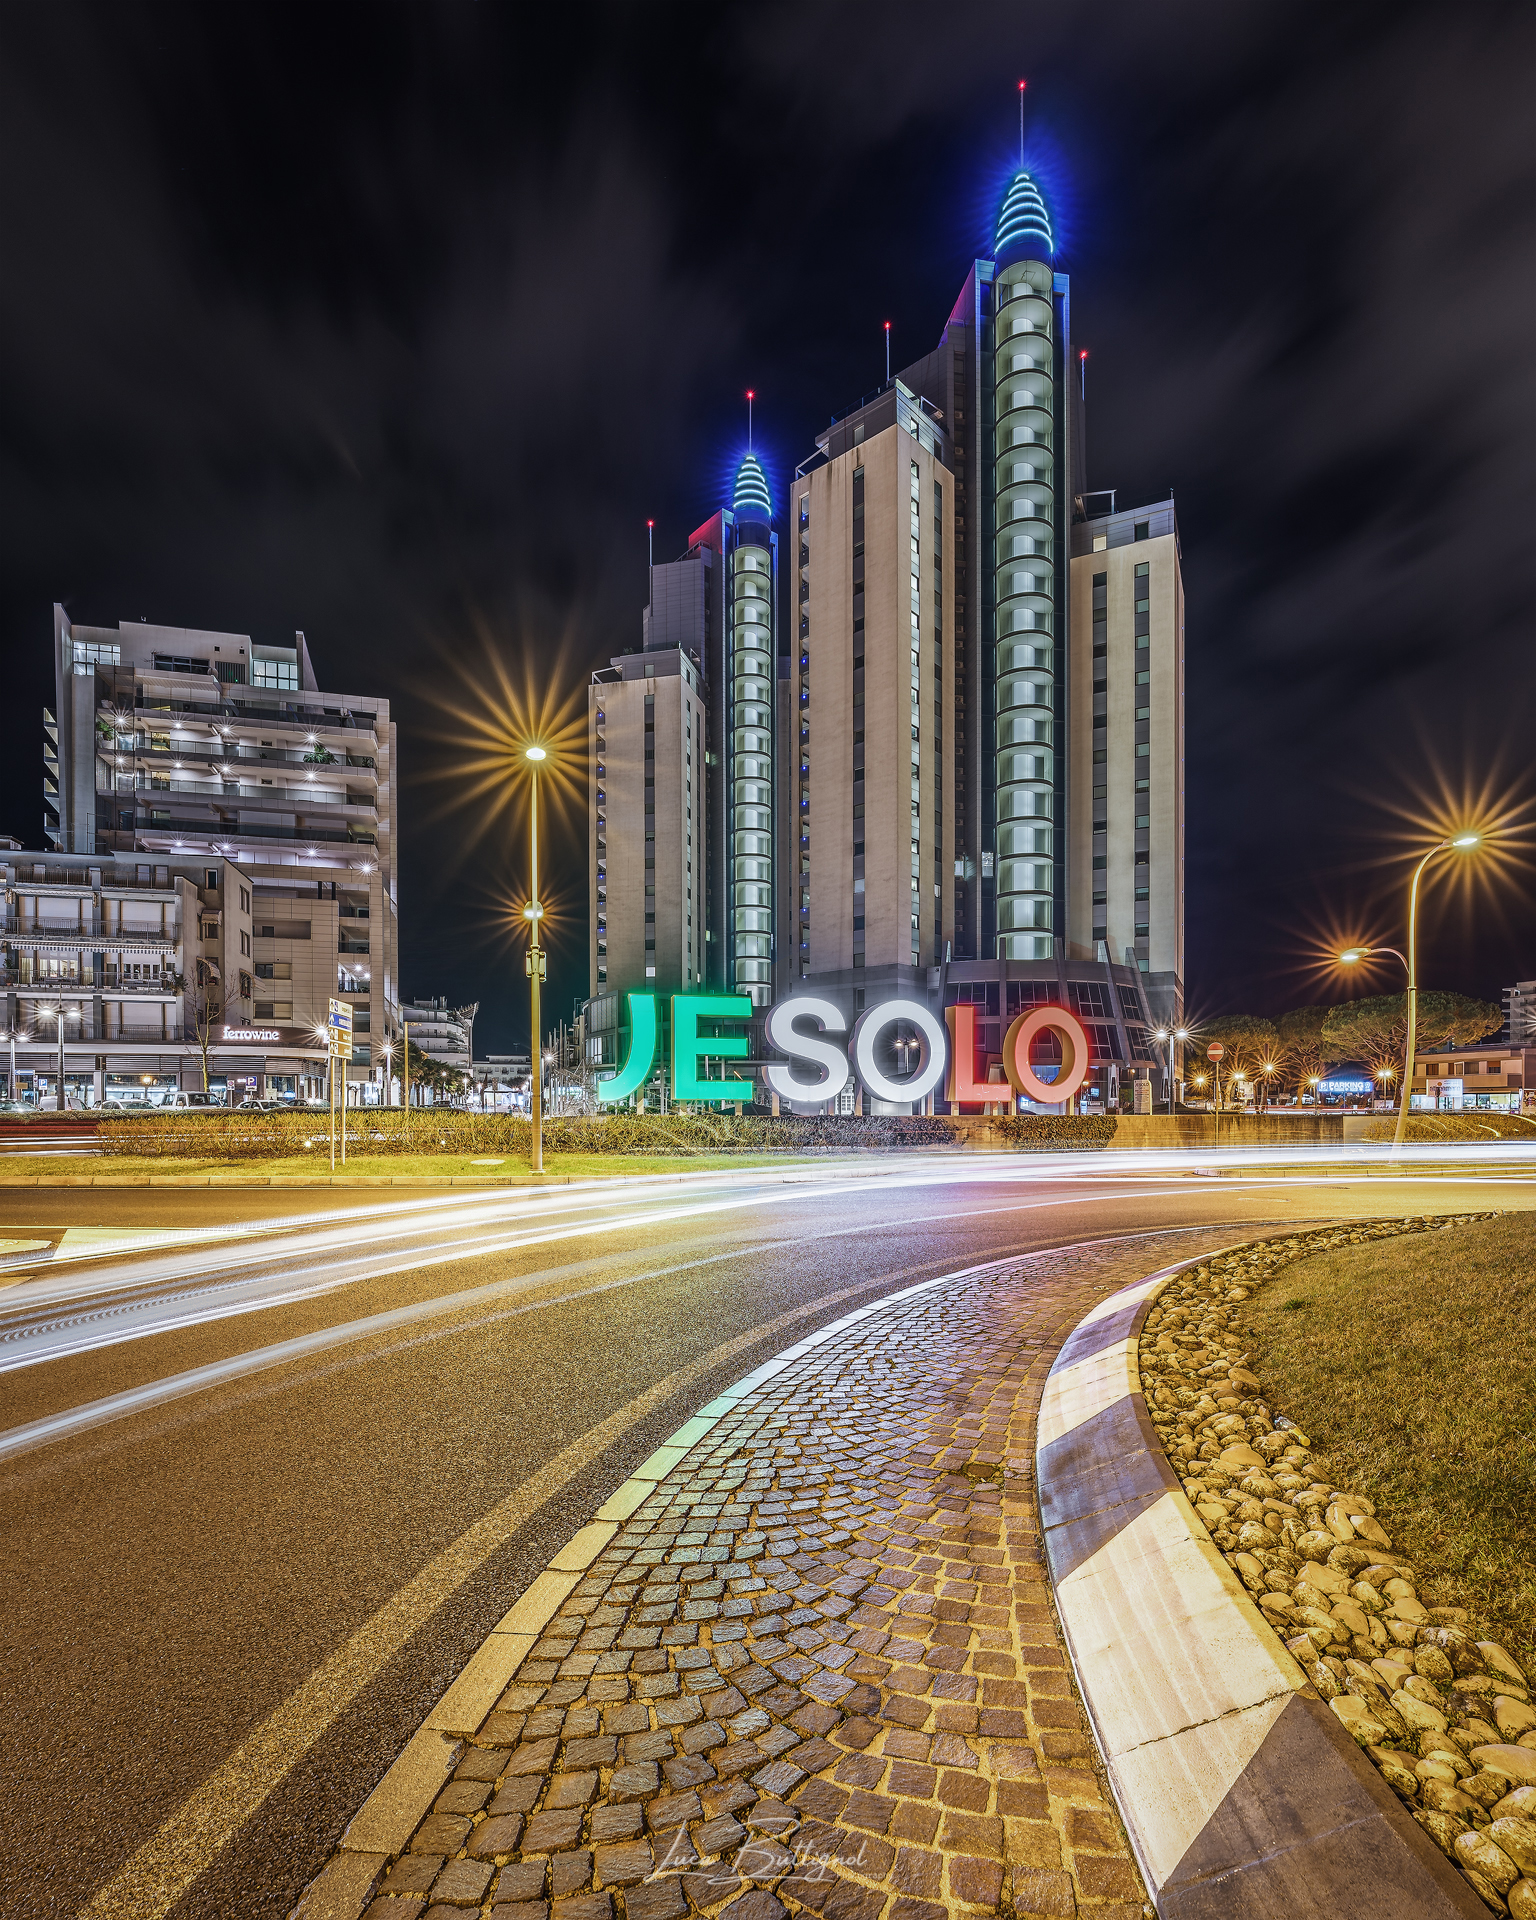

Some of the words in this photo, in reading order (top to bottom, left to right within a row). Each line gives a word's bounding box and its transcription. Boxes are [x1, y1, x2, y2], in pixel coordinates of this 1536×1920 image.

[223, 1025, 280, 1040] ferrowine
[599, 993, 1089, 1102] JESOLO
[248, 1077, 255, 1085] P
[1329, 1081, 1364, 1089] PARKING
